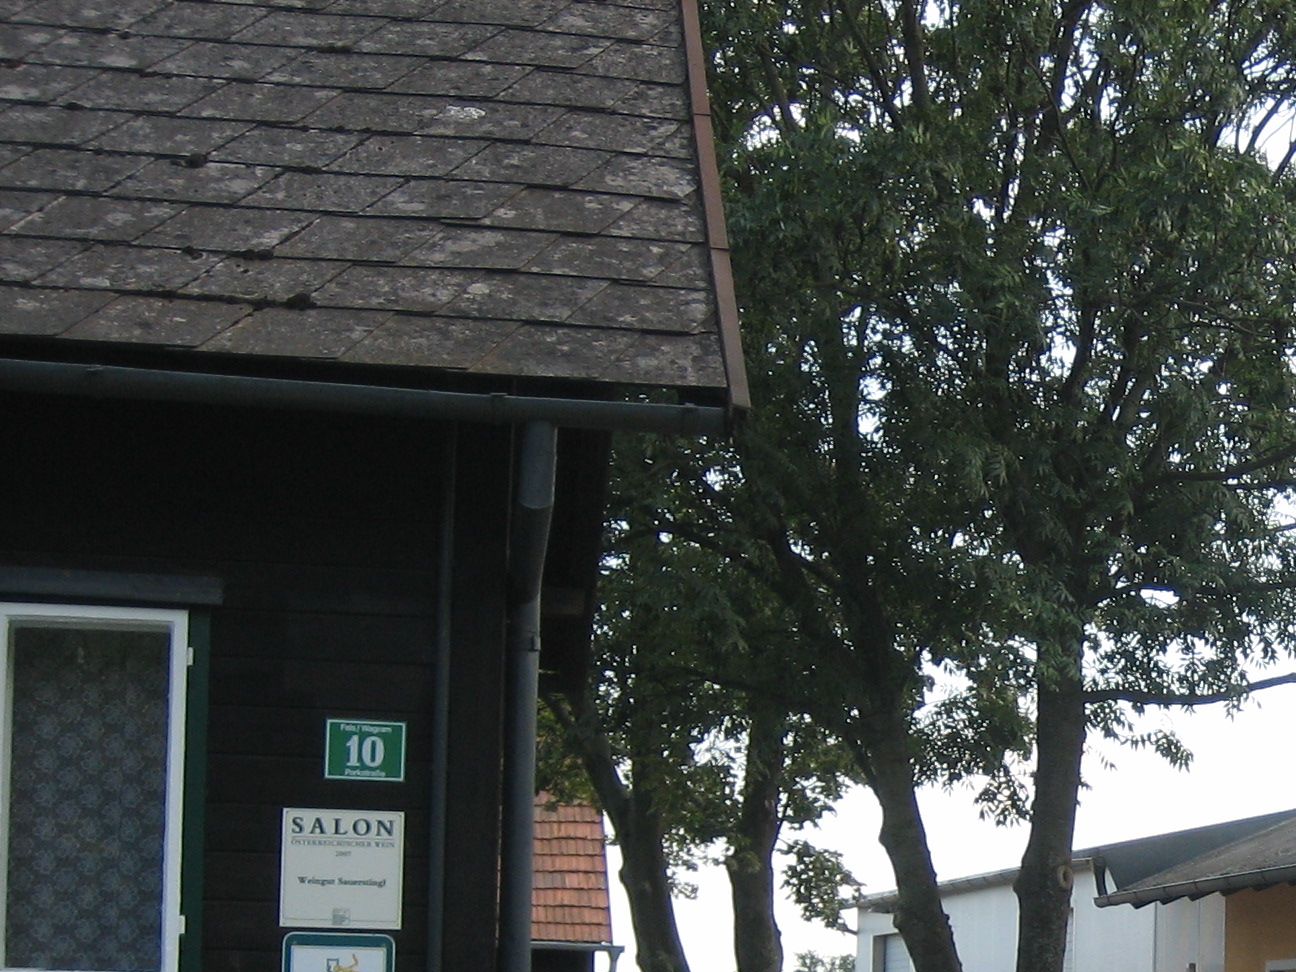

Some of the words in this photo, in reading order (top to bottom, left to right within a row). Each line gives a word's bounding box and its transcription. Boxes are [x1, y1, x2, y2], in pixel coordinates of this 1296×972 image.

[346, 734, 385, 768] 10
[291, 816, 395, 837] SALON
[297, 876, 335, 887] Weingut
